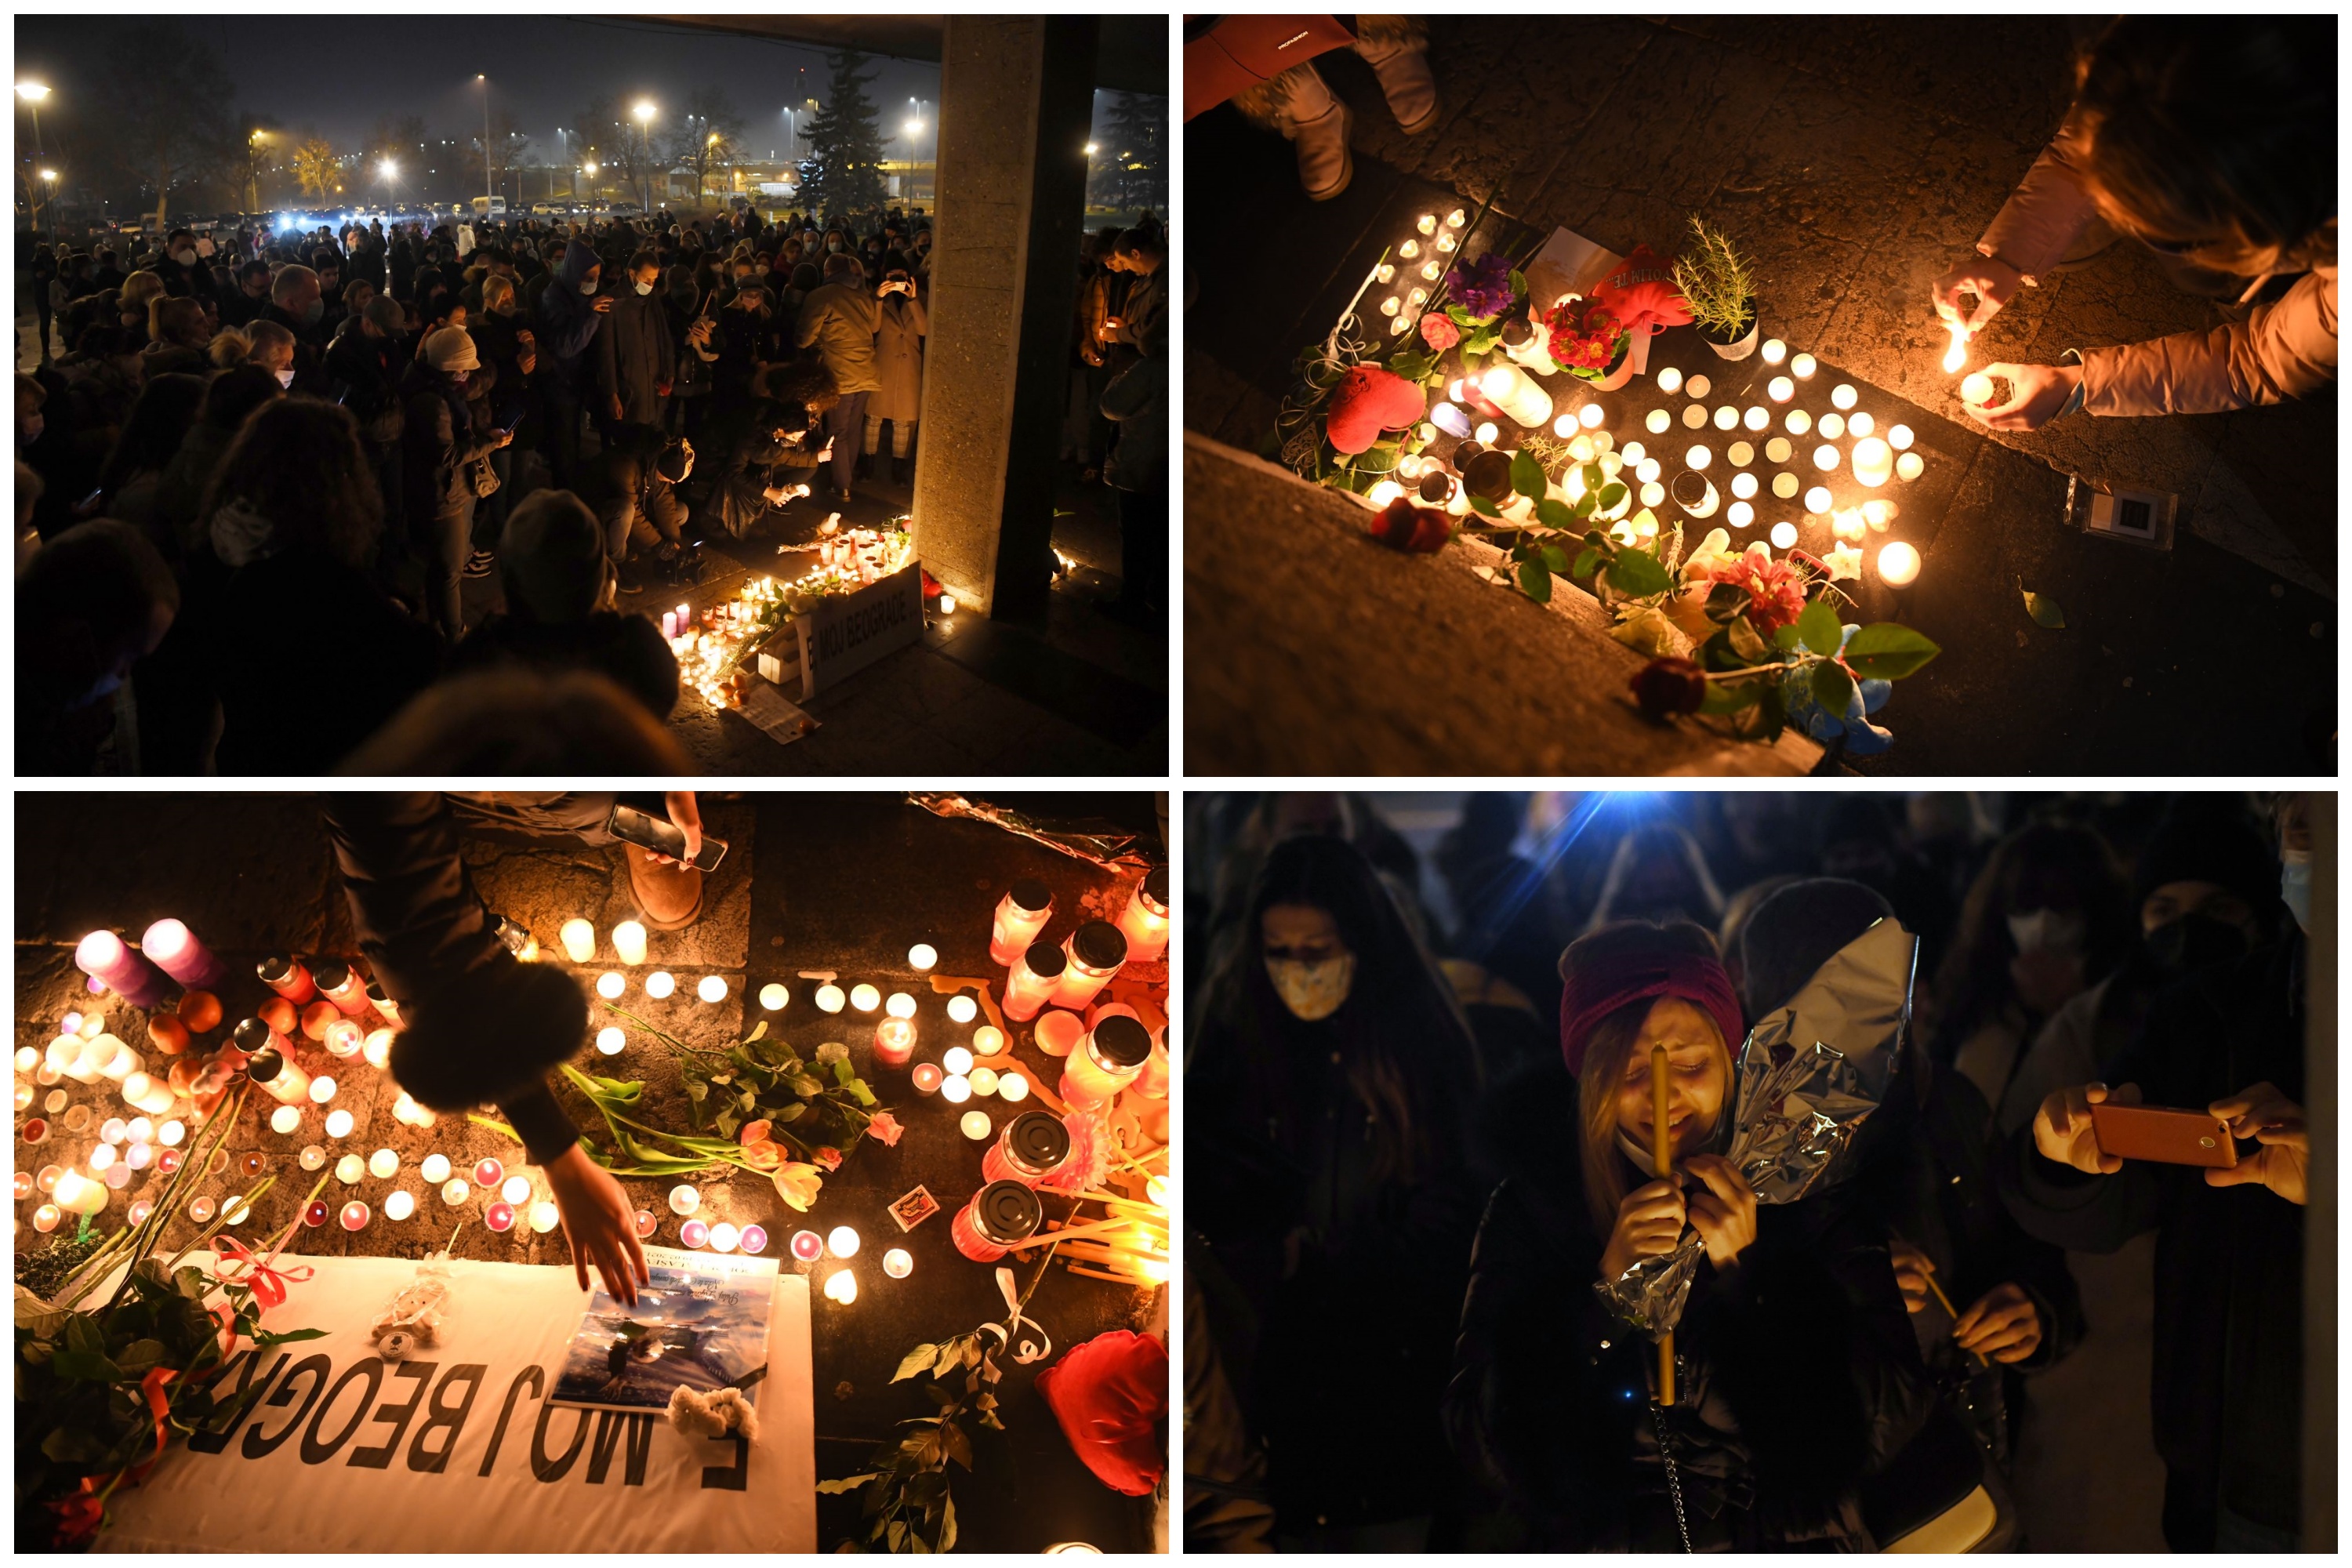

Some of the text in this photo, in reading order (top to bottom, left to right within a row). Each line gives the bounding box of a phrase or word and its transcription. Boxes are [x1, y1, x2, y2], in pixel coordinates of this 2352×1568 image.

[1278, 31, 1308, 50] PROFASHION
[1632, 269, 1670, 284] VOLIM
[818, 619, 844, 662] MOJ
[477, 1364, 655, 1486] MOJ
